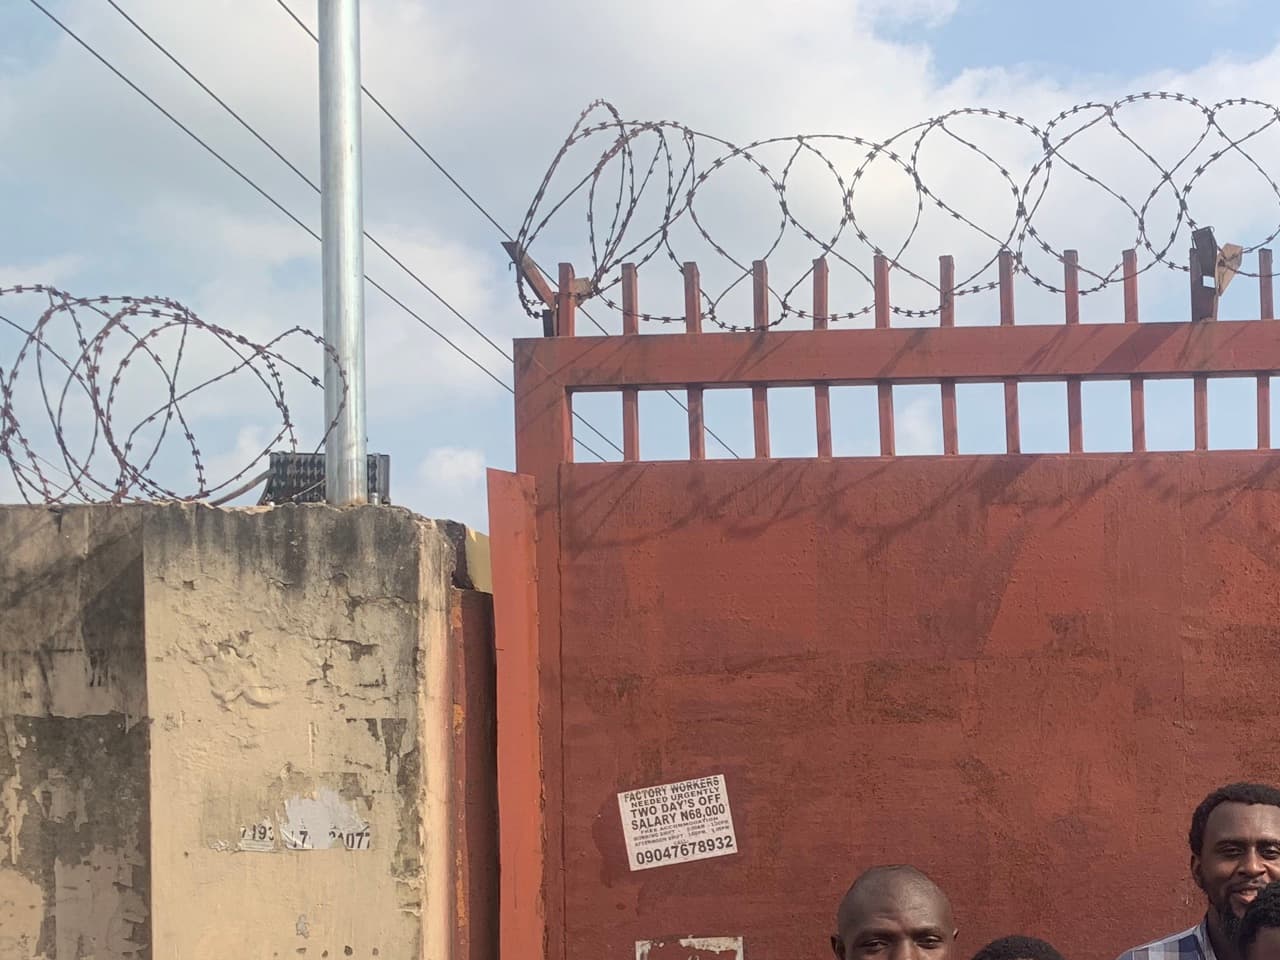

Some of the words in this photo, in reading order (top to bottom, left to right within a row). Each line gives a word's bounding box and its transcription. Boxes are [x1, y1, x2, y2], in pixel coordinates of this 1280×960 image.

[623, 786, 666, 802] FACTORY
[670, 776, 719, 793] WORKERS
[631, 796, 668, 808] NEEDED
[670, 786, 720, 800] URGENTLY
[629, 805, 657, 818] TWO
[660, 798, 695, 812] DAY'S
[698, 793, 721, 805] OFF
[630, 812, 677, 830] SALARY
[680, 803, 725, 822] N68,000
[635, 835, 733, 864] 09047678932
